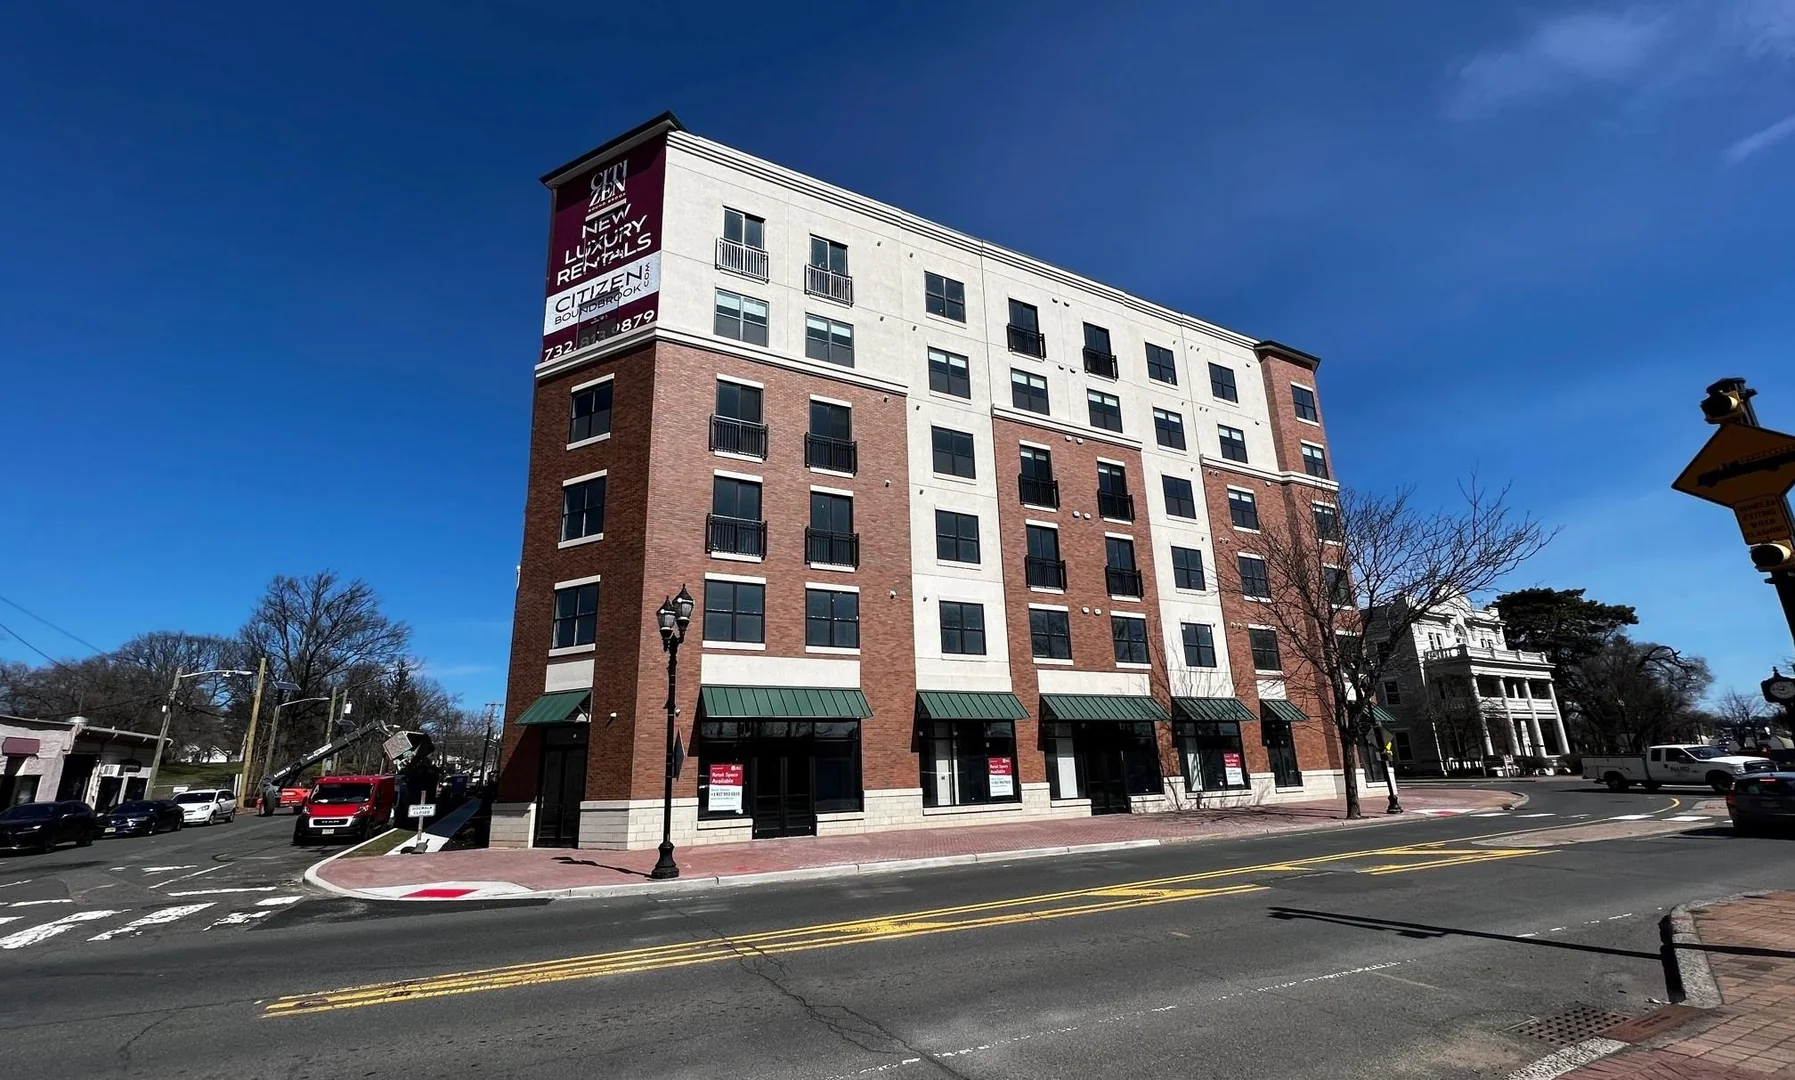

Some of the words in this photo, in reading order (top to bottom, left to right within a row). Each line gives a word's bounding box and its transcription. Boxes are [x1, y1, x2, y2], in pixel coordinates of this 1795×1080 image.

[589, 178, 627, 208] ZEN
[590, 158, 629, 191] CITI
[564, 214, 648, 265] LUXURY
[581, 203, 632, 239] NEW
[556, 232, 652, 287] RENTALS
[554, 265, 643, 314] CITIZEN
[554, 284, 642, 325] BOUNDBROOK
